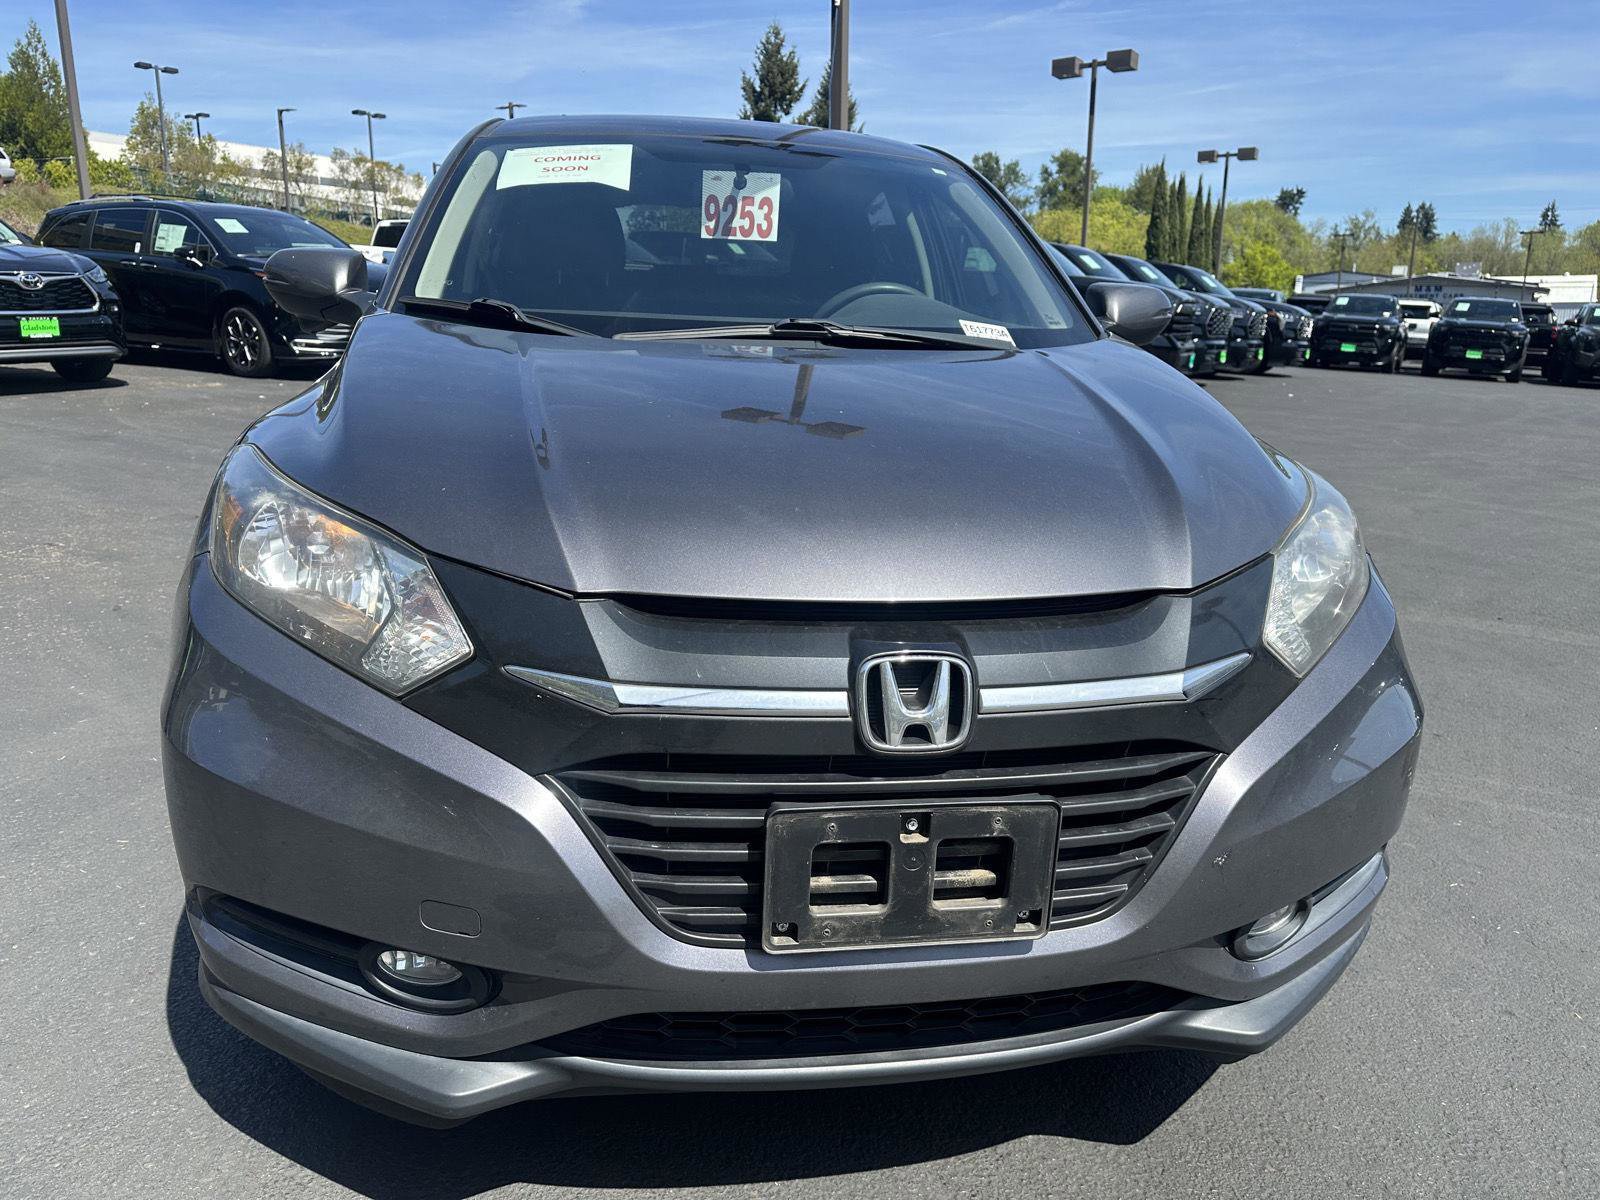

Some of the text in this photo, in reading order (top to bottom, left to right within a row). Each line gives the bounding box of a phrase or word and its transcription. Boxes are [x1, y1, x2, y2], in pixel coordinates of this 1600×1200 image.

[534, 154, 601, 163] COMING
[541, 165, 589, 173] SOON
[704, 193, 774, 239] 9253
[964, 324, 1009, 338] T61773A
